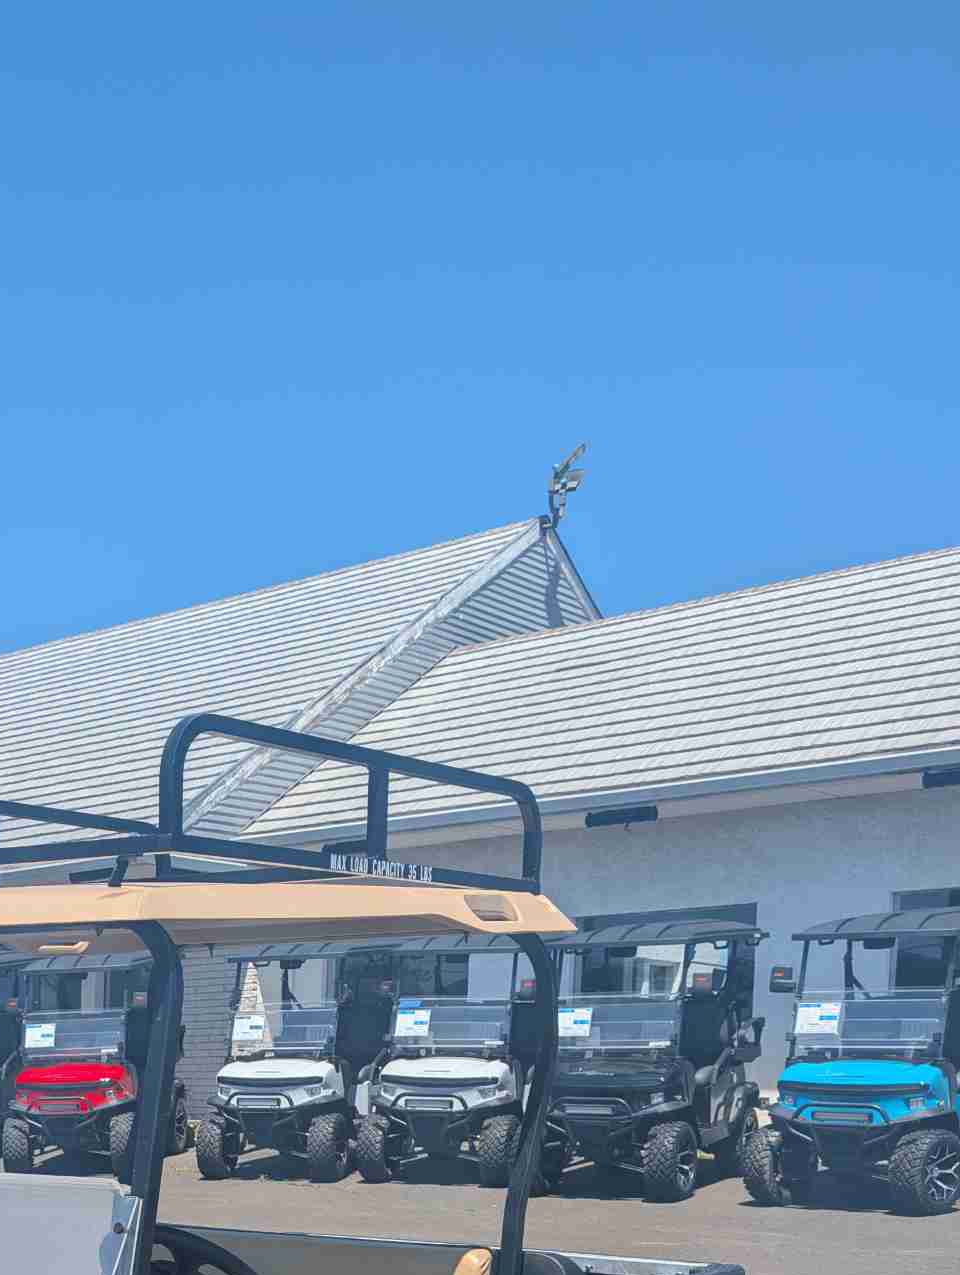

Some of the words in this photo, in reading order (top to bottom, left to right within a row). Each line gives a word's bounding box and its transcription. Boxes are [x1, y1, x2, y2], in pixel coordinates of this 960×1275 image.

[330, 852, 347, 871] MAX
[350, 855, 369, 873] LOAD
[372, 859, 405, 878] CAPACITY
